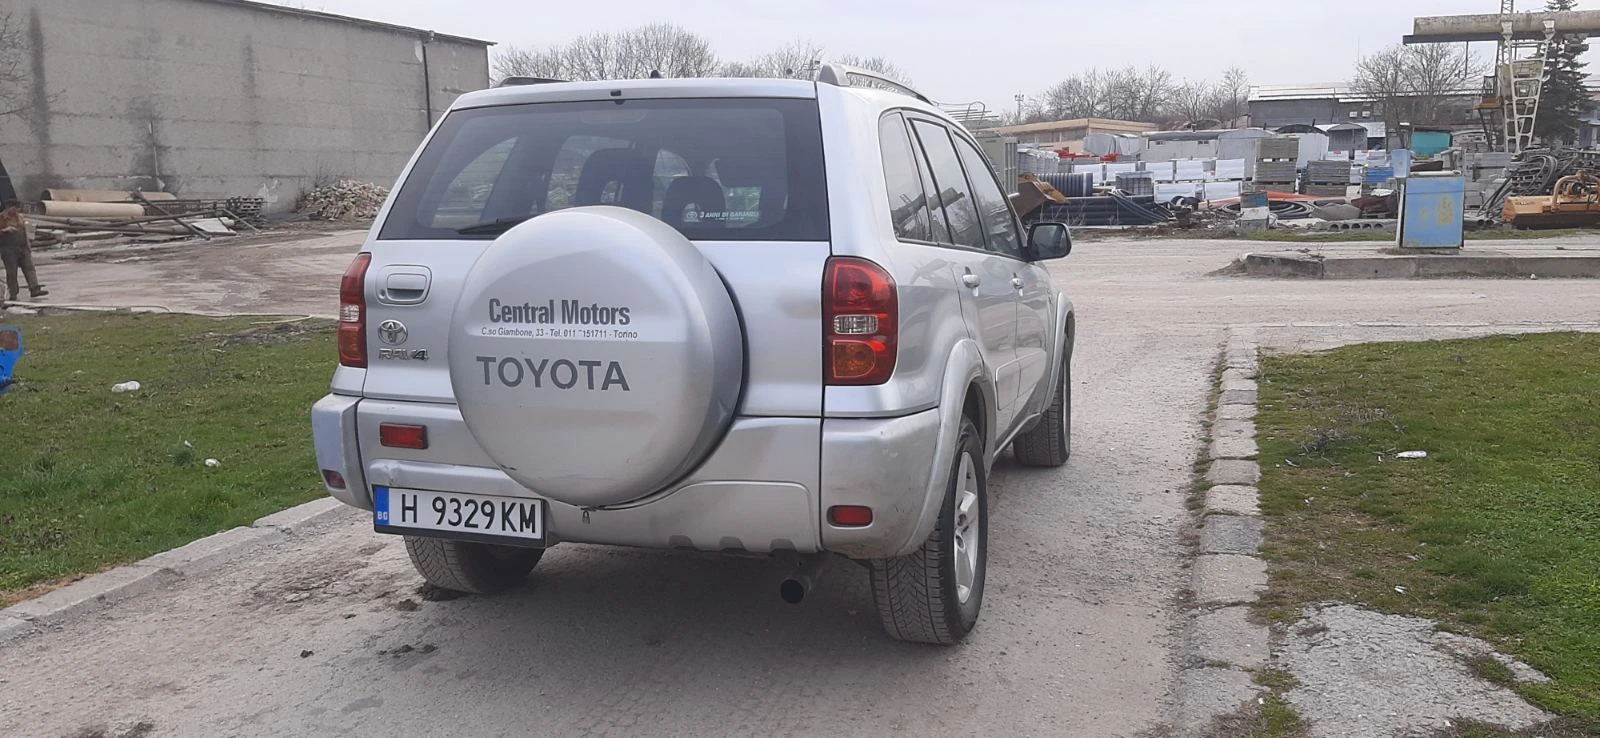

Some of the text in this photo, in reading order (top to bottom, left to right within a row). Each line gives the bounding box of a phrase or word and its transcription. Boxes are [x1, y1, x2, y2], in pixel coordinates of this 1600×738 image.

[488, 298, 631, 326] Central Motors
[481, 326, 497, 336] C.so
[535, 328, 545, 337] 33
[549, 329, 562, 338] Tel.
[563, 329, 576, 338] 011
[578, 329, 607, 338] 151711
[614, 330, 638, 339] Torino
[476, 356, 631, 392] TOYOTA
[377, 511, 388, 520] BG
[401, 494, 418, 523] H
